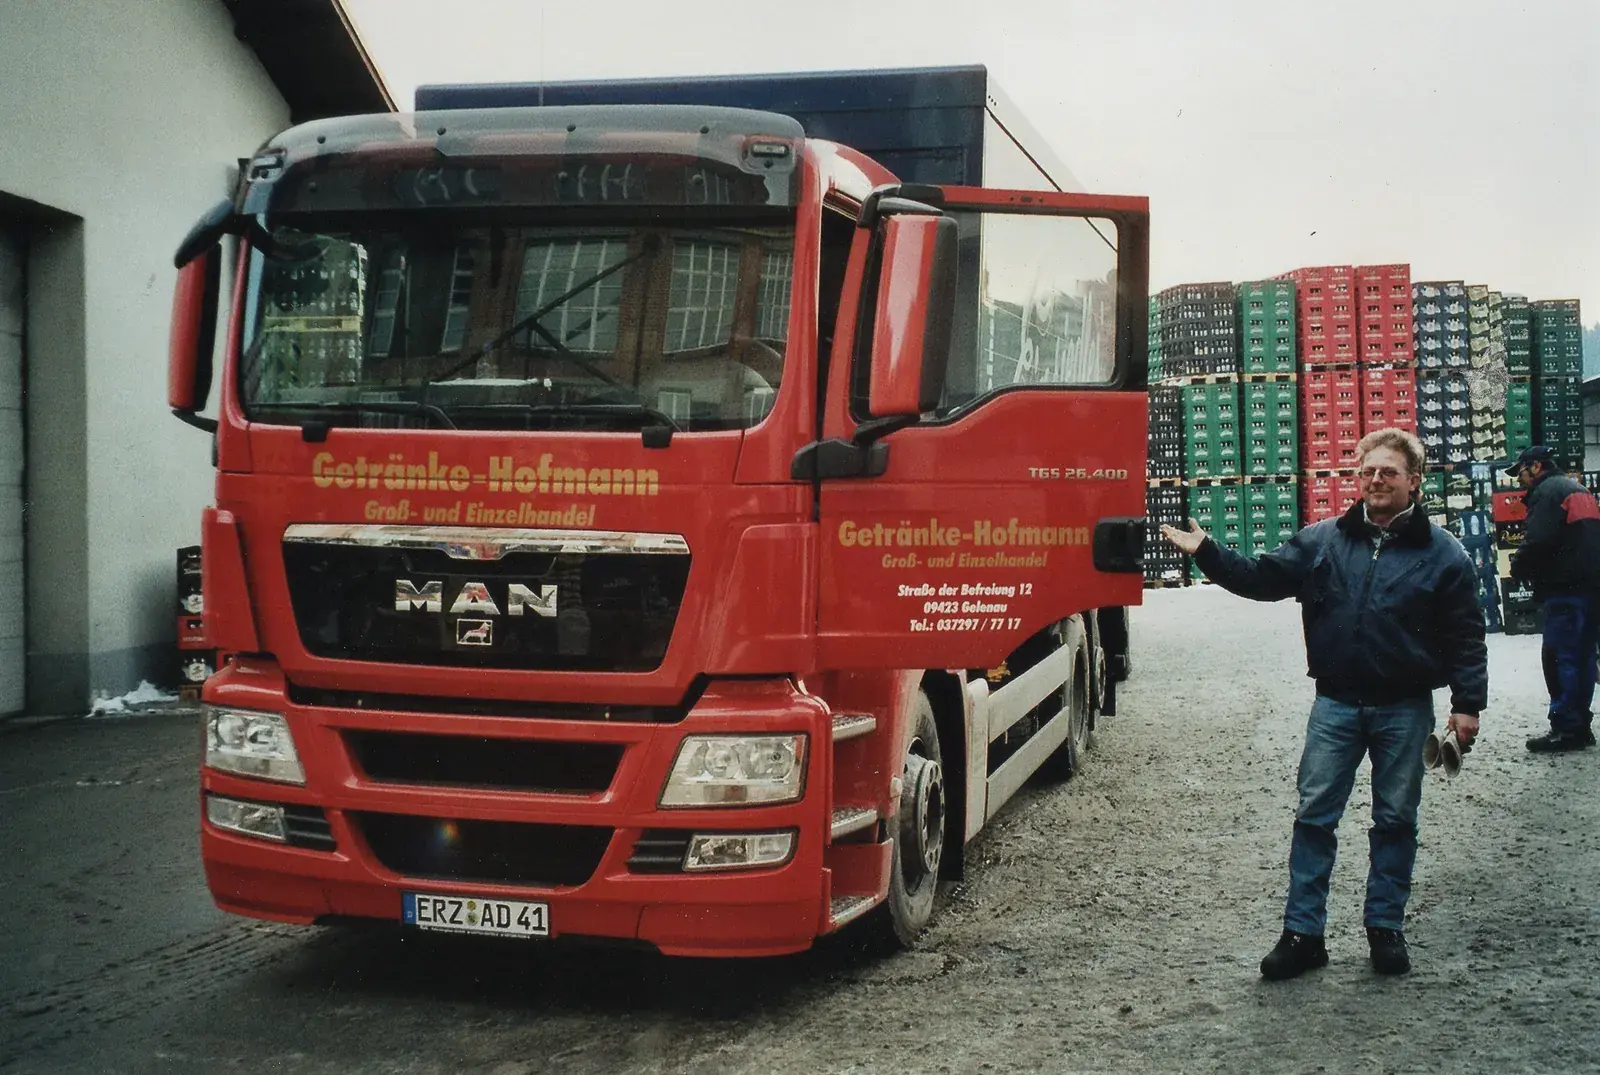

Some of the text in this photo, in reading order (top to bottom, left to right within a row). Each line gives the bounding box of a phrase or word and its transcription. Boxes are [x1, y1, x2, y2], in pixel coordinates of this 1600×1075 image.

[313, 451, 660, 496] Getränke-Hofmann
[1028, 467, 1129, 481] TGS 26.400
[364, 500, 597, 527] Groß- und Einzelhandel
[838, 518, 1090, 547] Getränke-Hofmann
[882, 552, 1048, 568] Groß- und Einzelhandel
[395, 578, 559, 618] MAN
[898, 583, 1033, 599] Straße der Befreiung 12
[923, 601, 1008, 614] 09423 Gelenau
[910, 619, 934, 633] Tel.:
[936, 618, 980, 632] 037297
[989, 618, 1006, 630] 77
[1006, 618, 1022, 630] 17
[416, 897, 547, 931] ERZ AD 41
